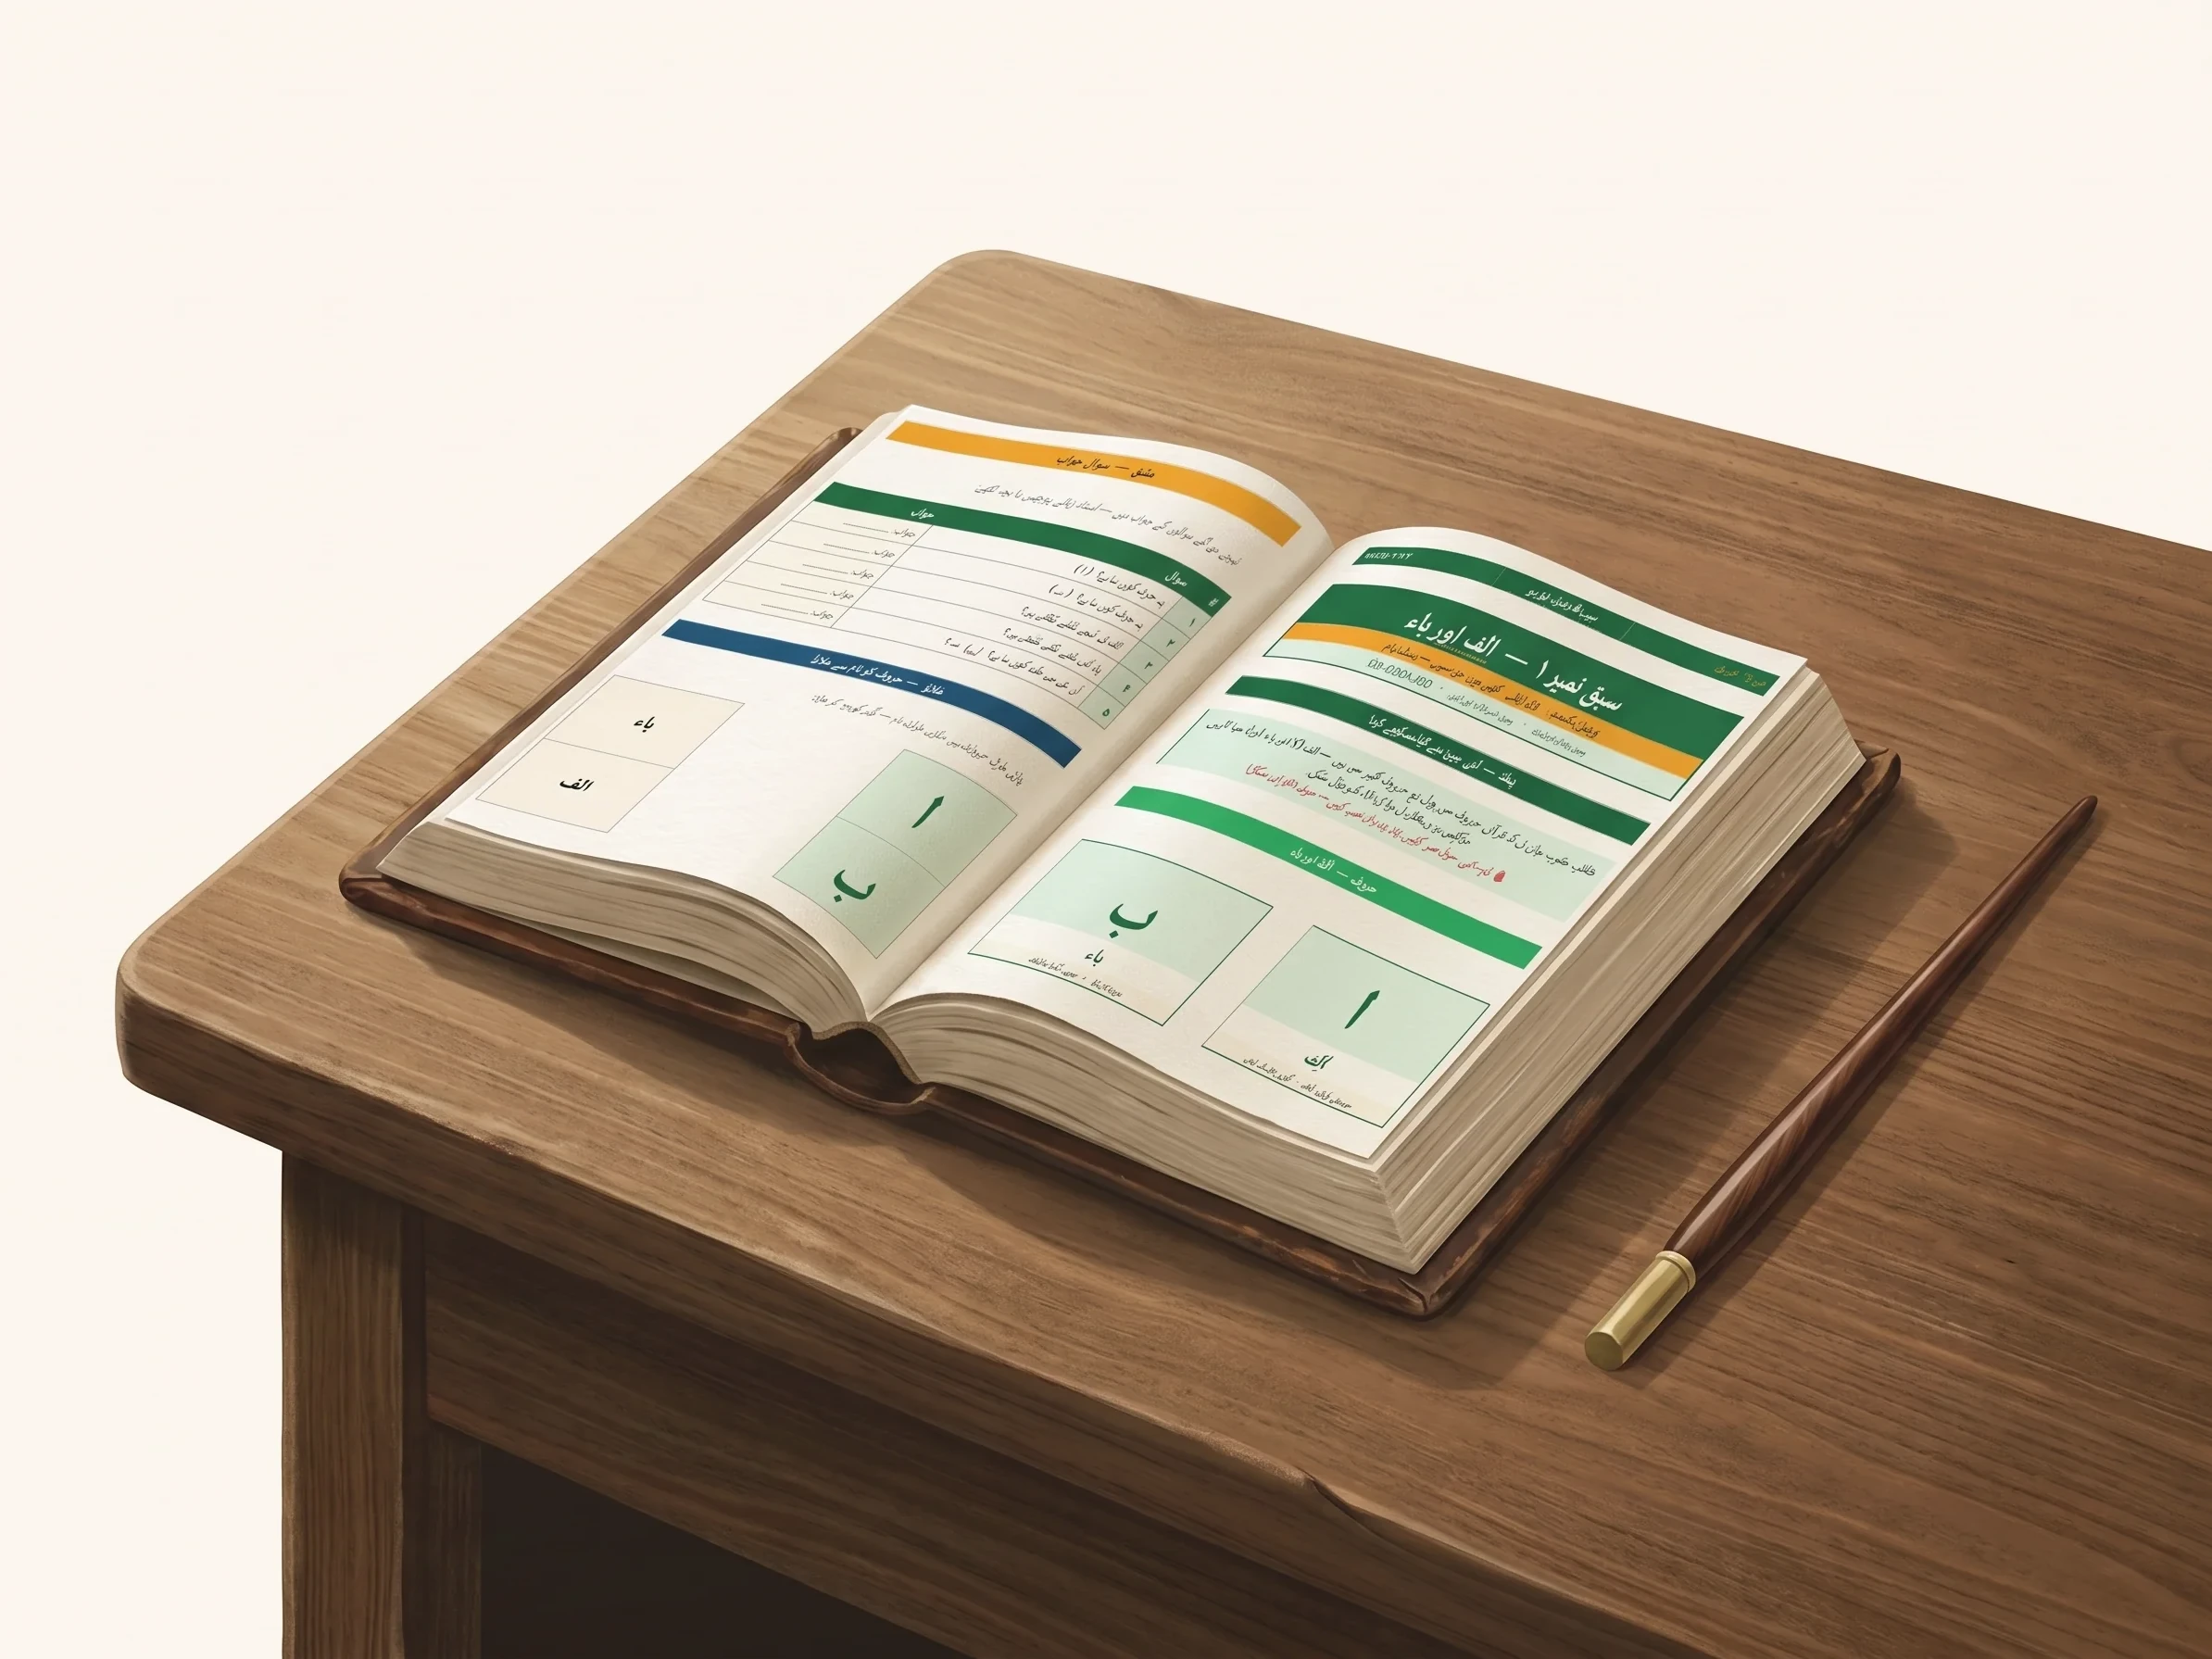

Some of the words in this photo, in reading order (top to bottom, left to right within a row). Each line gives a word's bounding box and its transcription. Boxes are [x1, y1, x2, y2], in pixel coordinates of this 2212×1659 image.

[1404, 612, 1432, 637] باء
[1426, 625, 1467, 645] اور
[1463, 635, 1502, 657] الف
[1578, 685, 1623, 711] سبق
[634, 716, 655, 733] باء
[1102, 709, 1111, 717] ۵
[559, 778, 595, 792] الف
[911, 796, 945, 828] ا
[834, 869, 876, 902] ب
[1109, 903, 1159, 939] ب
[1085, 949, 1104, 967] باء
[1344, 990, 1380, 1029] ا
